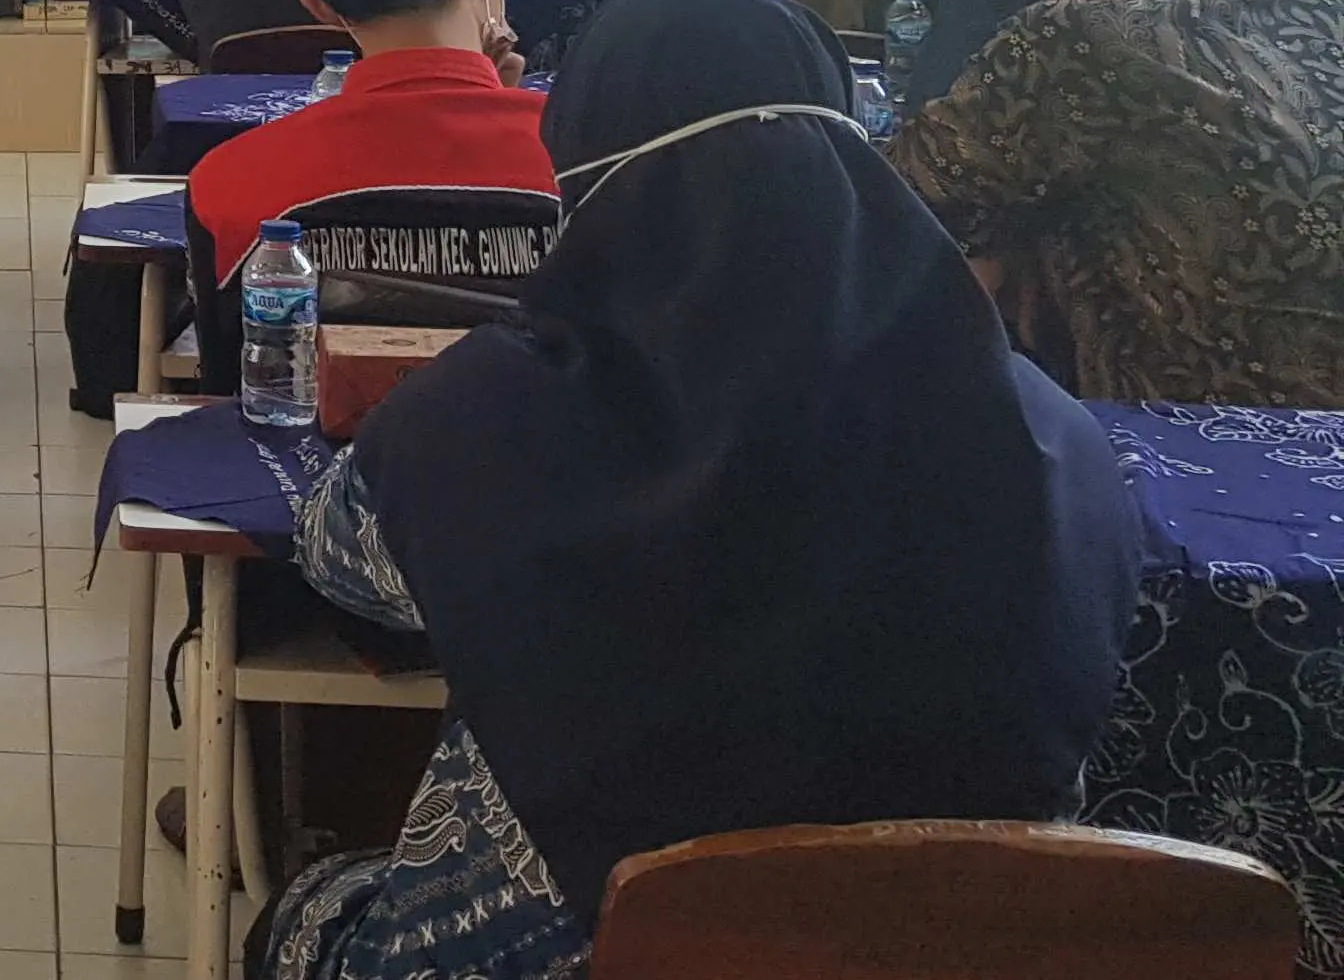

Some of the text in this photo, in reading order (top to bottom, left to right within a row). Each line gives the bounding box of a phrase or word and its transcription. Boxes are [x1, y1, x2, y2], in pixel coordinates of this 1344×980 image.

[300, 226, 366, 272] PERATOR
[371, 226, 437, 275] SEKOLAH
[440, 226, 475, 276] KEC.
[477, 226, 540, 277] GUNUNG
[250, 293, 285, 311] AQUA
